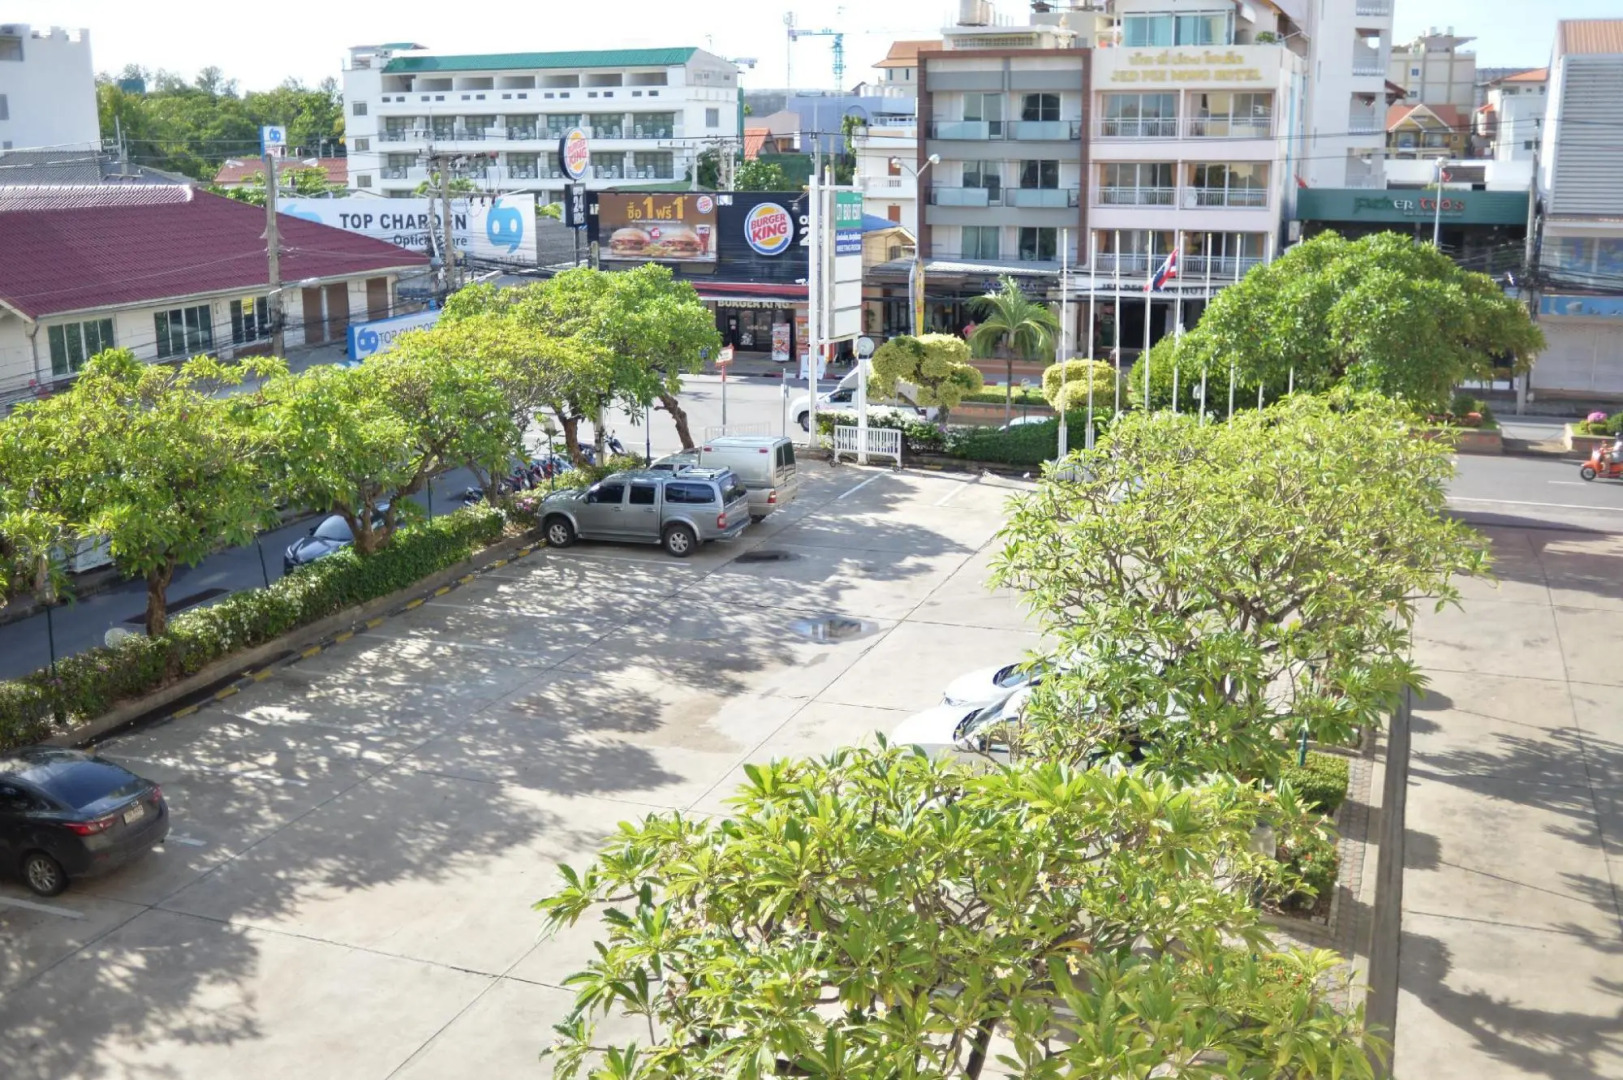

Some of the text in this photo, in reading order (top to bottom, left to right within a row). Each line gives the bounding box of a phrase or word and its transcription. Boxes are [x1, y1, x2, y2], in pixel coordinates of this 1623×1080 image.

[1214, 68, 1262, 81] HOTEL
[567, 138, 586, 153] BURGER
[569, 147, 587, 165] KING
[573, 195, 583, 212] 24
[339, 213, 373, 229] TOP
[751, 213, 786, 230] BURGER
[752, 222, 788, 242] KING
[718, 300, 790, 309] BURGER KING
